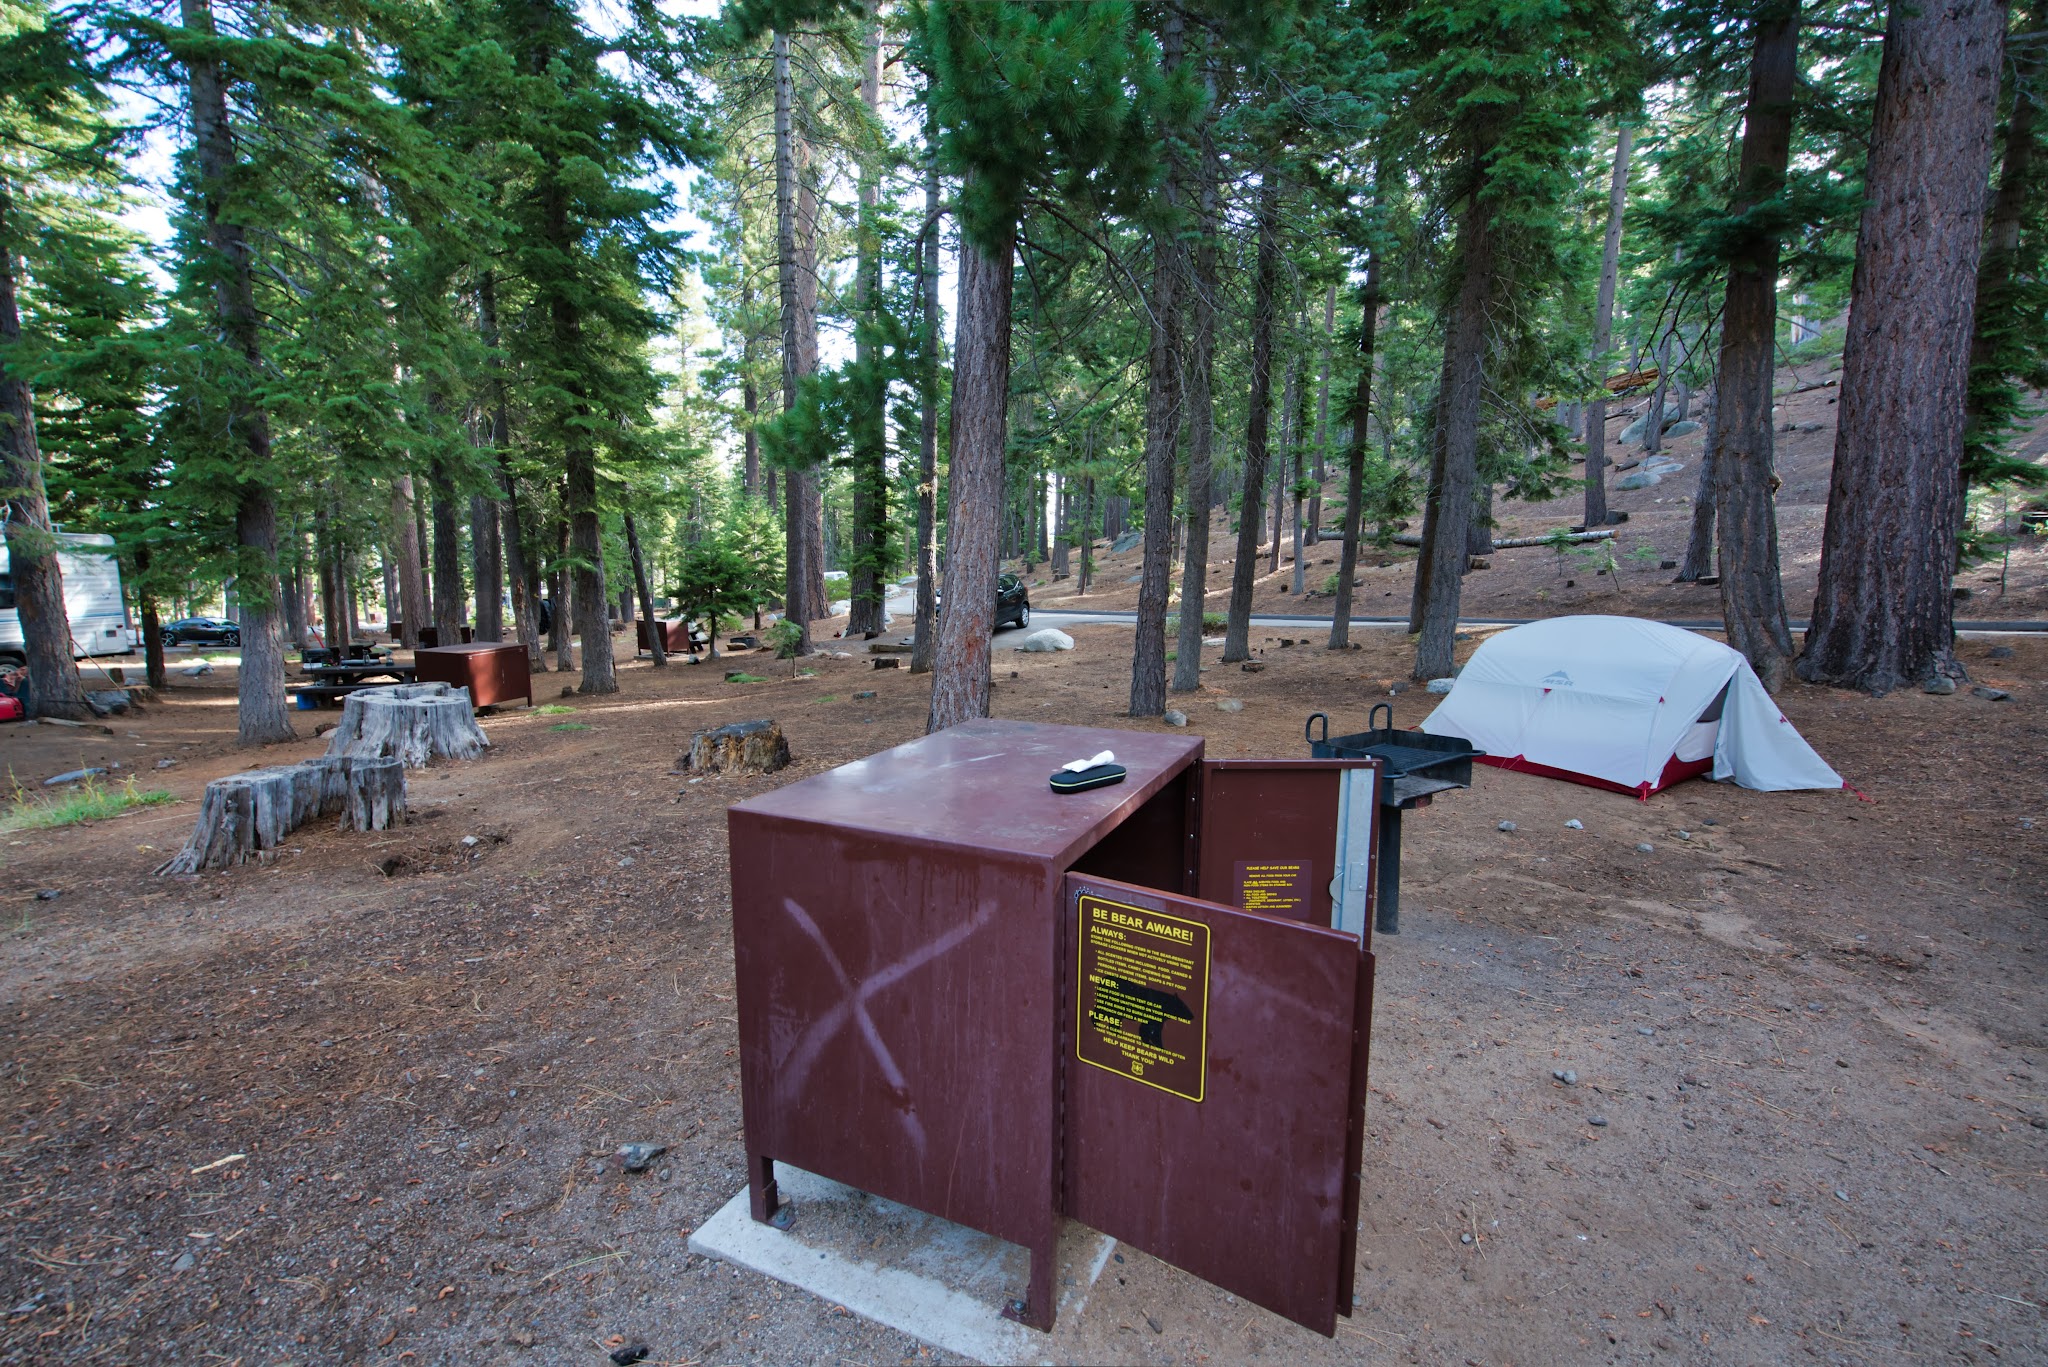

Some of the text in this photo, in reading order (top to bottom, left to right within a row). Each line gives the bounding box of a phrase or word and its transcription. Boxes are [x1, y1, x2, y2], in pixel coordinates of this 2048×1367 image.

[1093, 908, 1193, 941] BE BEAR AWARE!
[1091, 926, 1126, 940] ALWAYS:
[1112, 940, 1133, 948] FOLLOWING
[1098, 962, 1117, 970] PERSONAL
[1136, 961, 1156, 969] INCLUDING
[1090, 975, 1119, 989] NEVER:
[1128, 978, 1146, 986] COOLERS
[1097, 1005, 1116, 1014] APPROACH
[1120, 1000, 1145, 1010] UNATTENDED
[1089, 1011, 1122, 1027] PLEASE:
[1144, 1014, 1163, 1022] GARBAGE
[1123, 1032, 1142, 1040] CAMPSITE
[1117, 1035, 1135, 1043] GARBAGE
[1150, 1046, 1171, 1055] DUMPSTER
[1104, 1037, 1174, 1065] HELP KEEP BEARS WILD
[1122, 1050, 1154, 1066] THANK YOU!
